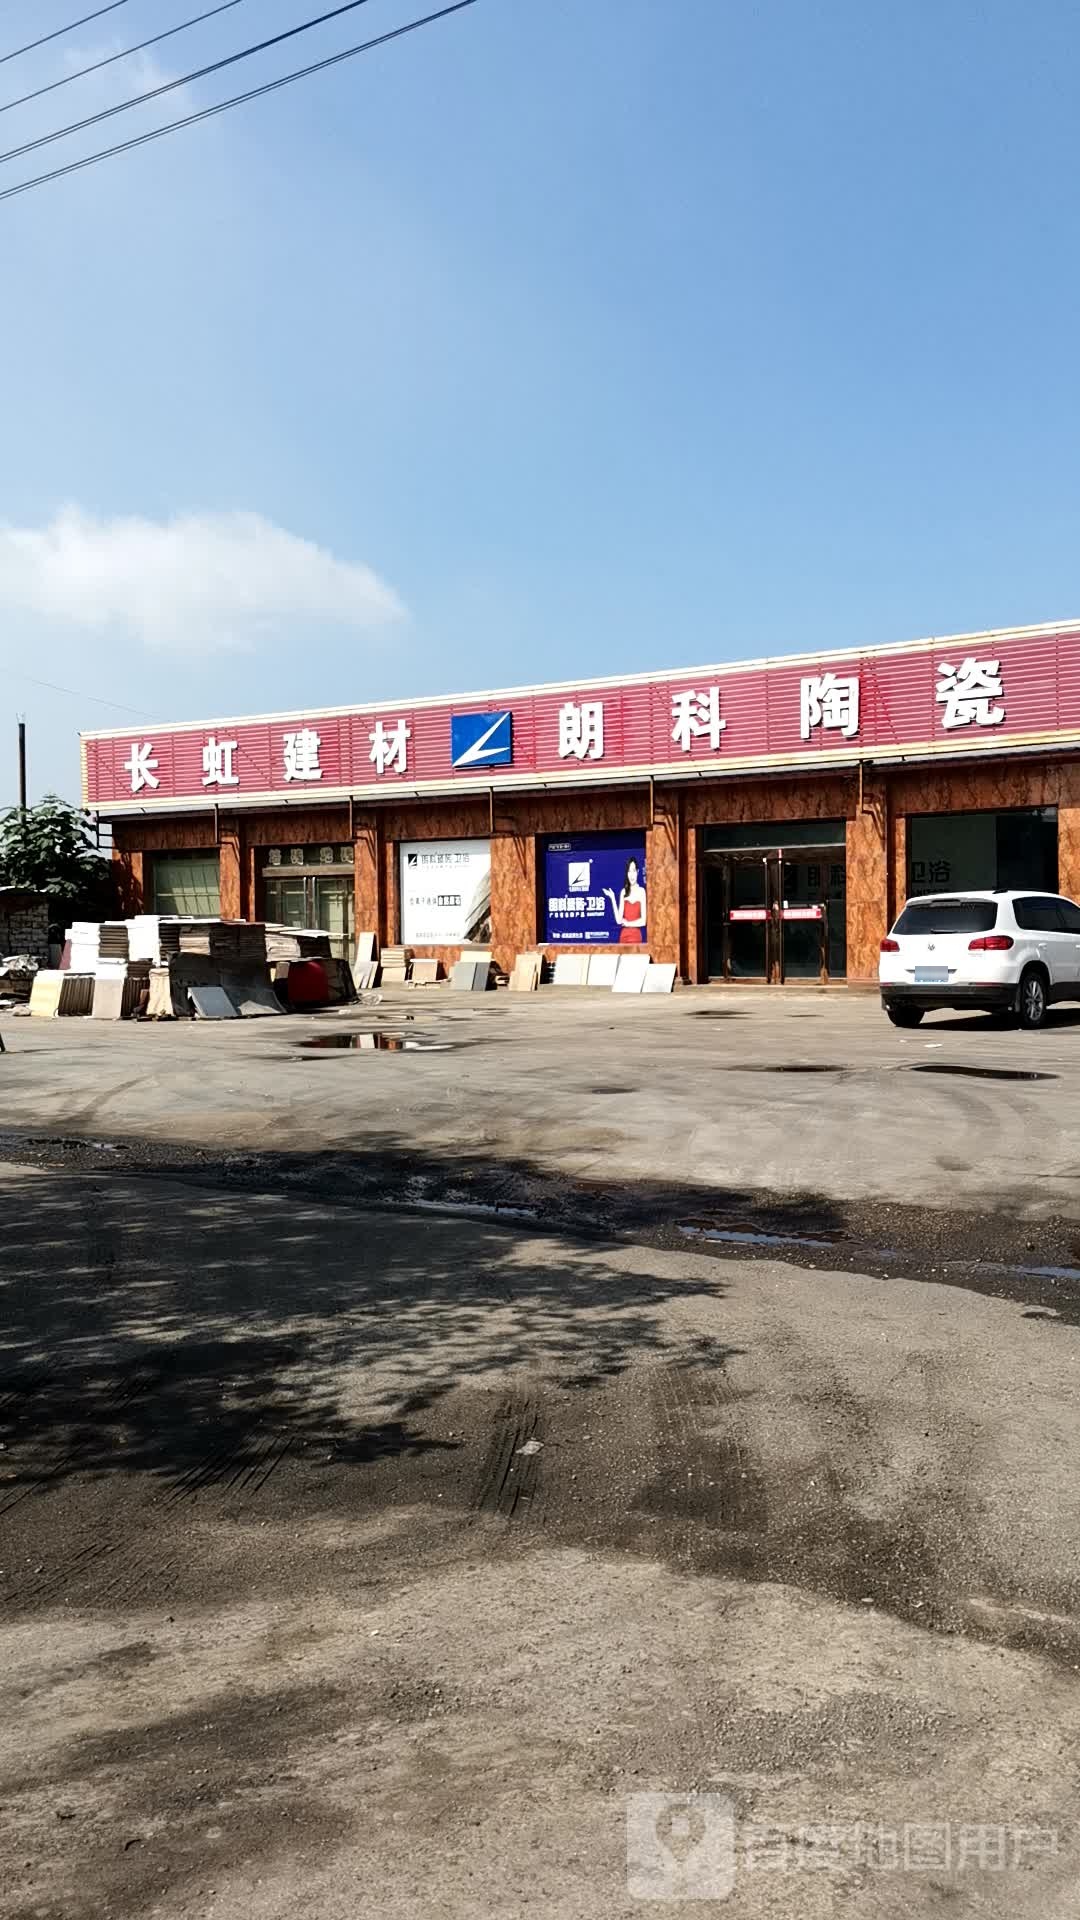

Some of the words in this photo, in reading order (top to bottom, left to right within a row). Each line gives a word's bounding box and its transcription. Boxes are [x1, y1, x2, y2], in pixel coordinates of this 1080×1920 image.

[124, 719, 411, 793] 长虹建材
[557, 657, 1006, 760] 朗科陶瓷
